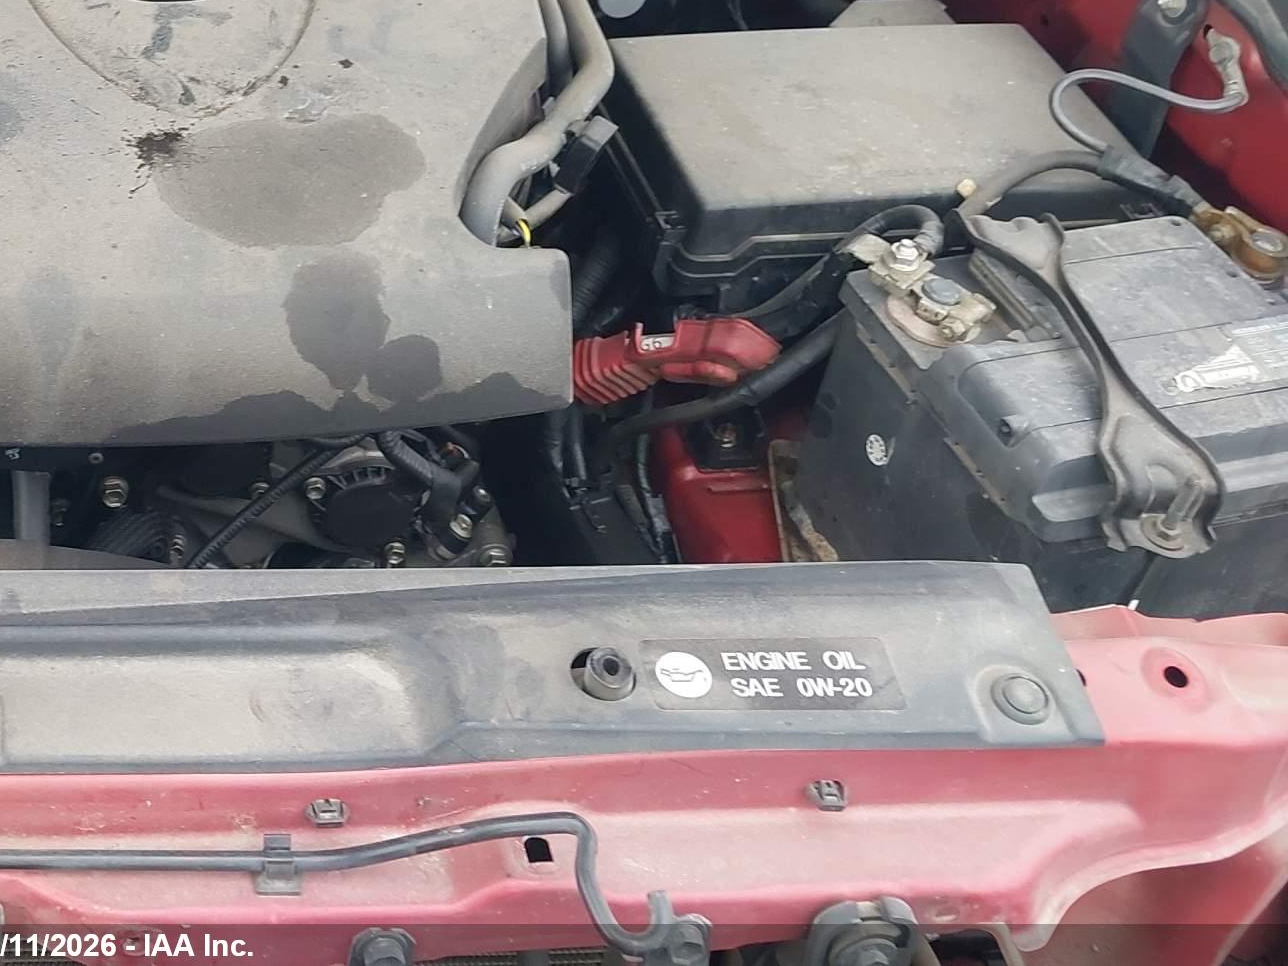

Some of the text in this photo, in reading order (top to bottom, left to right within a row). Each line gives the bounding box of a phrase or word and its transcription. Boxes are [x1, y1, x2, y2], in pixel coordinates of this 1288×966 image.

[720, 650, 866, 671] ENGINE OIL
[730, 677, 873, 697] SAE 0W-20
